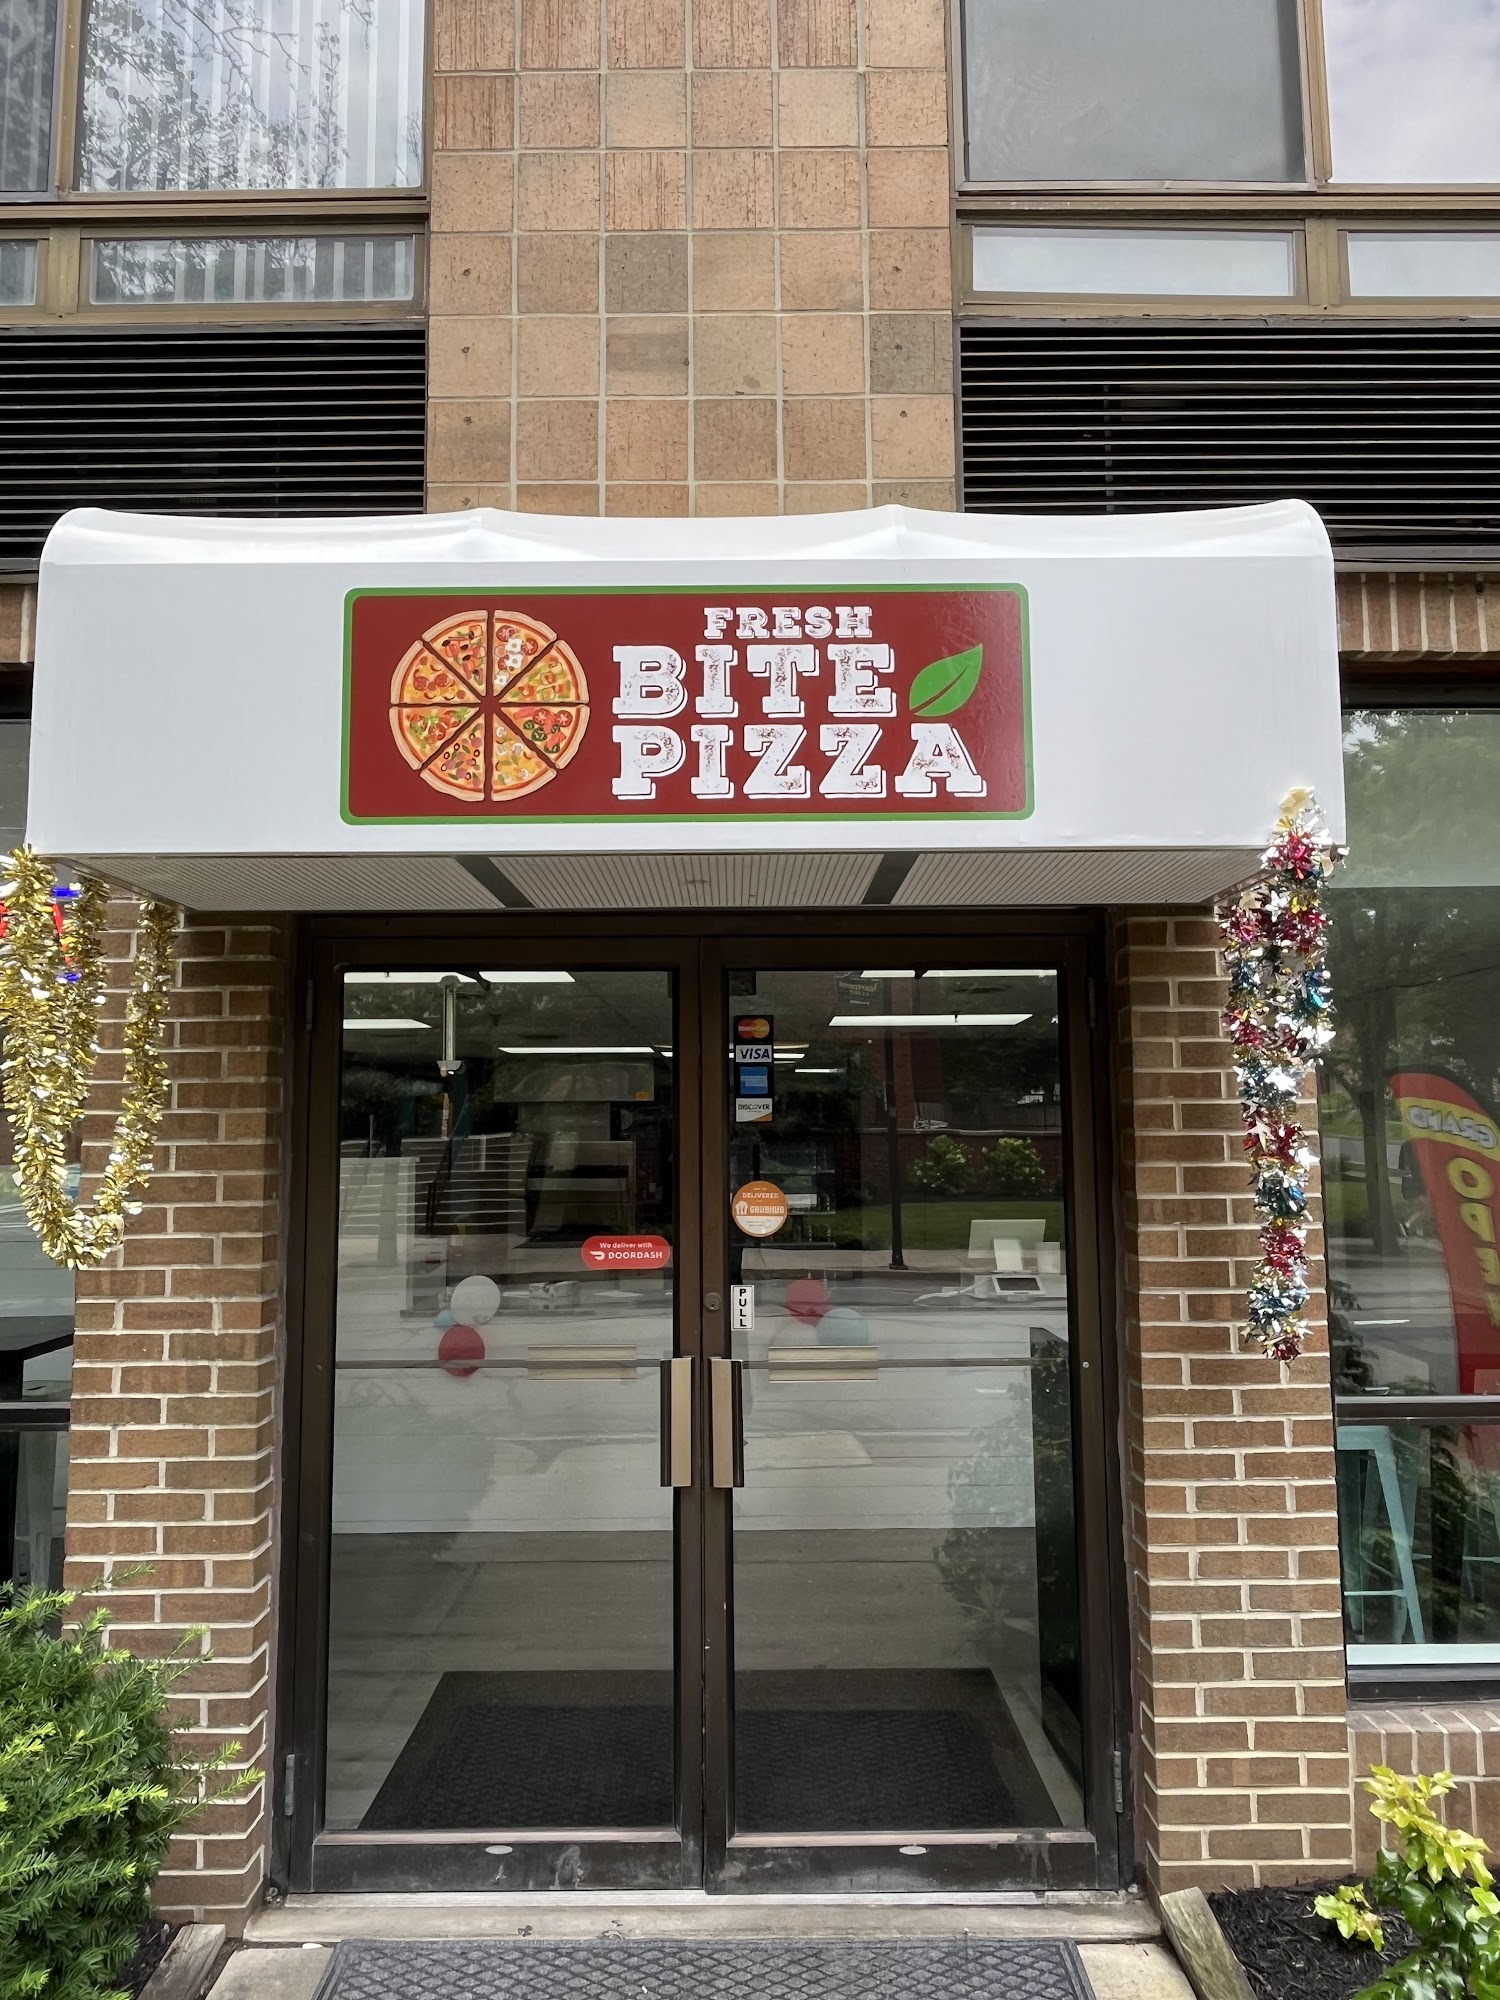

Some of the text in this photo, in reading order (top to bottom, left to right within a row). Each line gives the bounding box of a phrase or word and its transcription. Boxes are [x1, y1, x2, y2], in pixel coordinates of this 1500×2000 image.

[704, 606, 873, 639] FRESH
[612, 642, 896, 718] BITE
[612, 722, 987, 799] PIZZA
[740, 1048, 770, 1059] VISA
[738, 1103, 770, 1111] DISCOVER
[608, 1251, 663, 1260] DOORDASH
[739, 1288, 747, 1327] PULL
